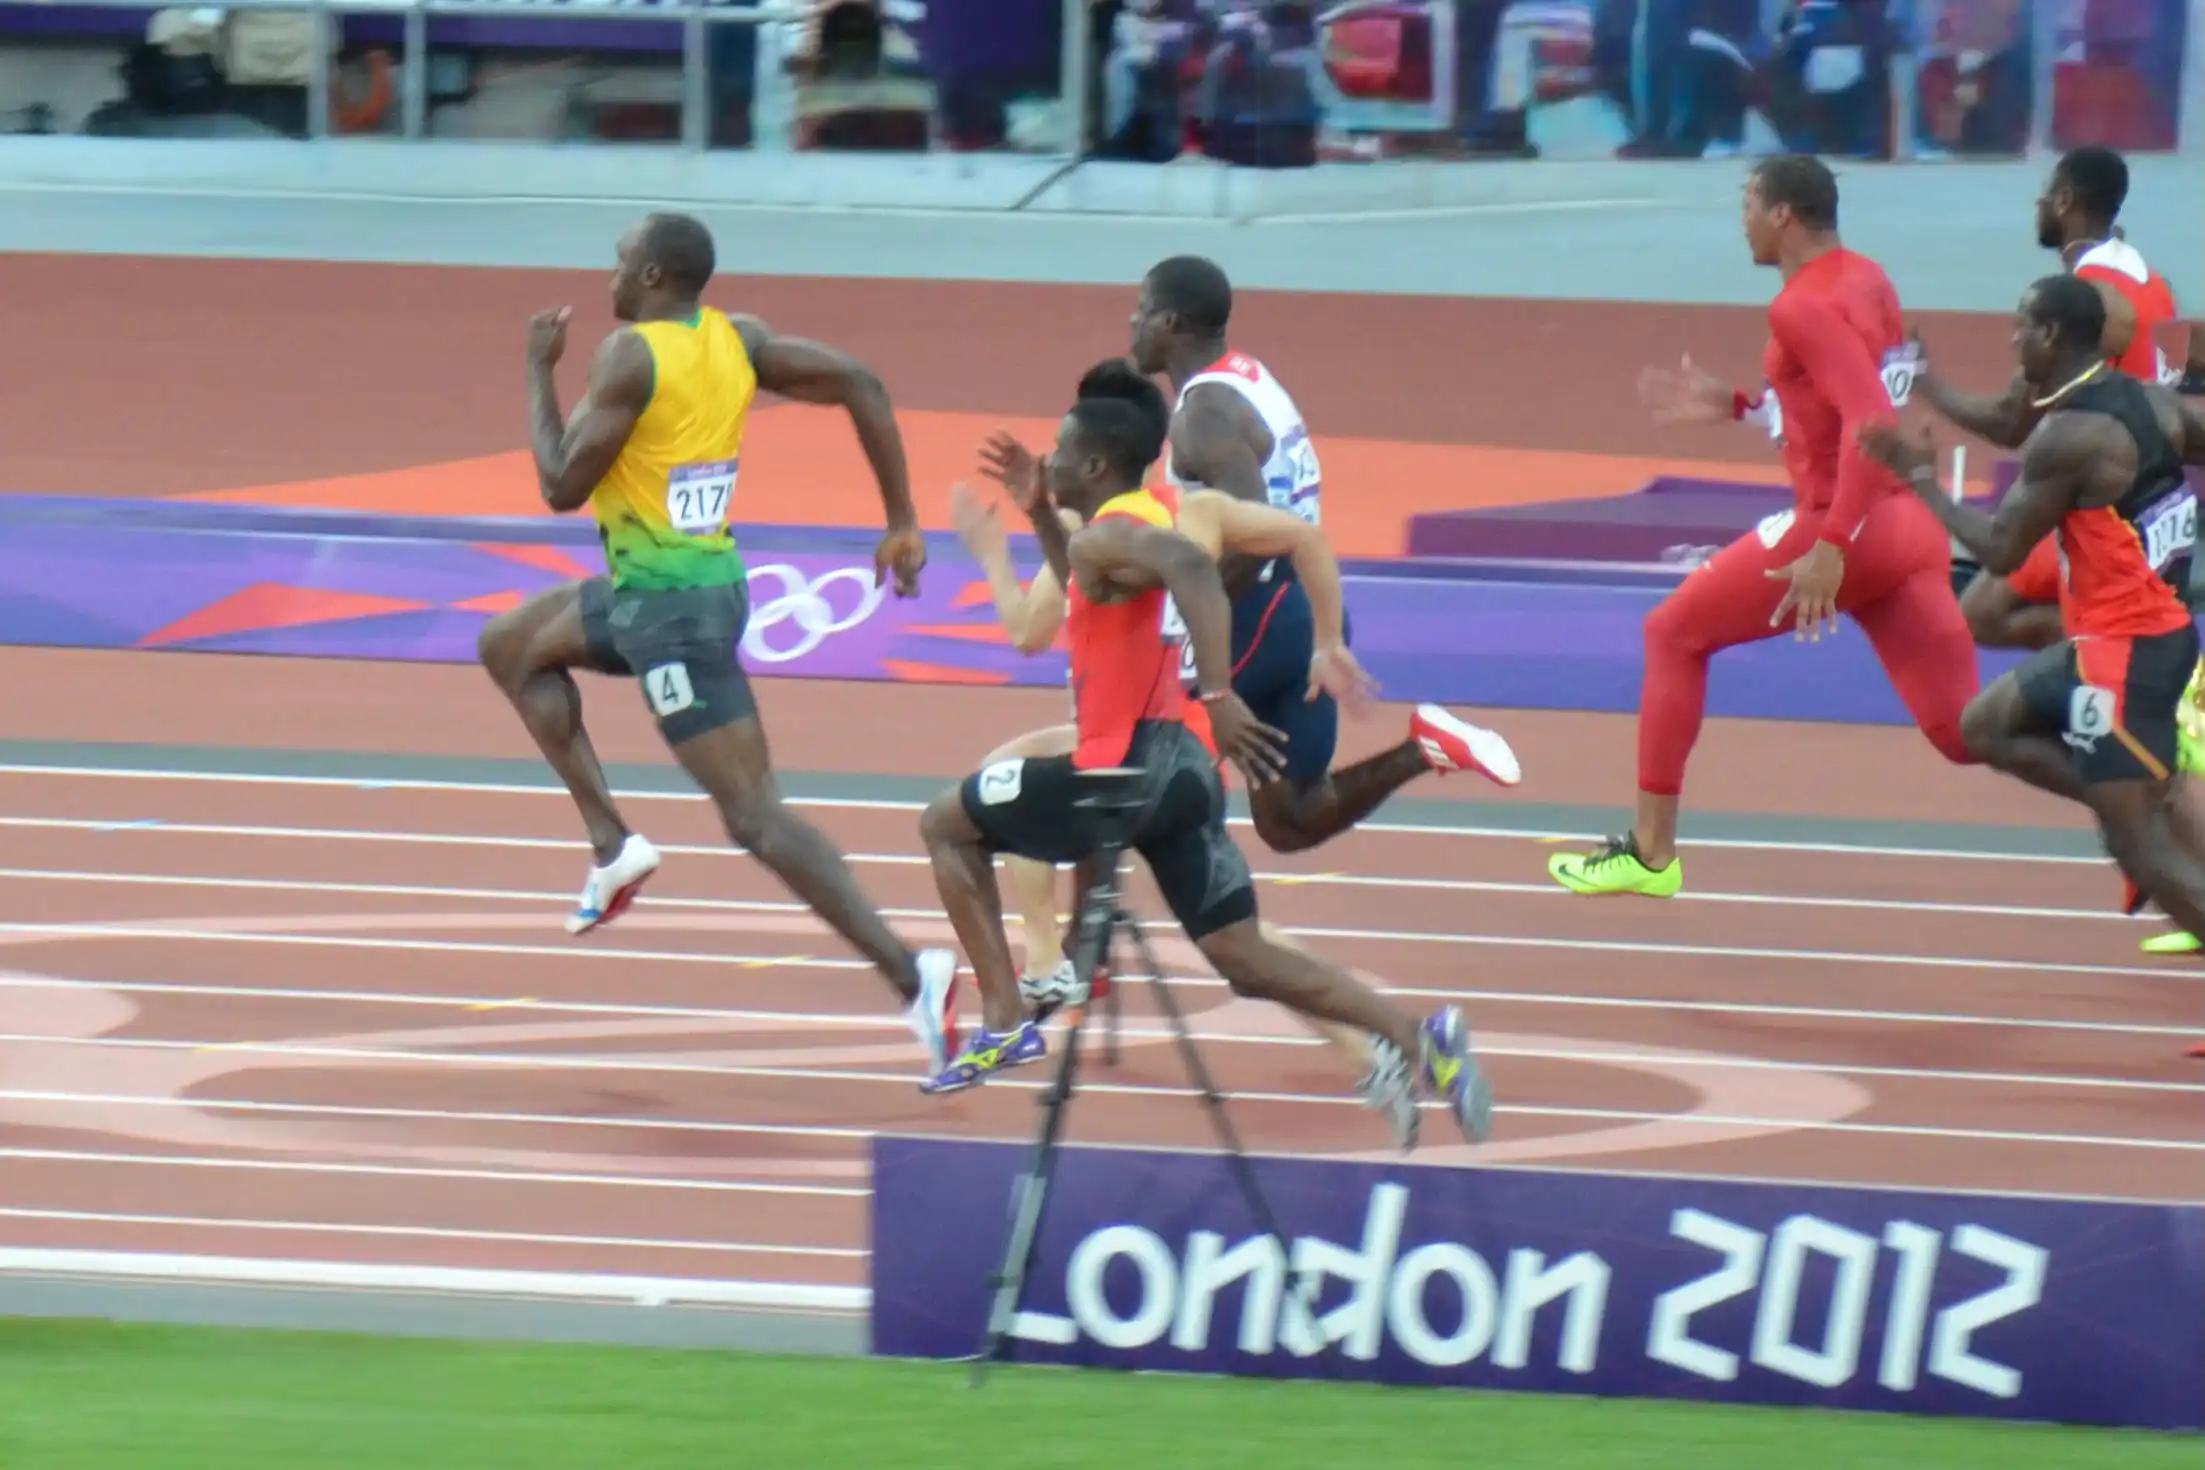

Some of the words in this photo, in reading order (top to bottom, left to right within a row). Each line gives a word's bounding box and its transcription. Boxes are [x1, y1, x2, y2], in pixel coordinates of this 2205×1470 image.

[662, 669, 679, 704] 4
[2081, 690, 2099, 729] 6
[985, 768, 1016, 791] 2
[1646, 1207, 2050, 1399] 2012
